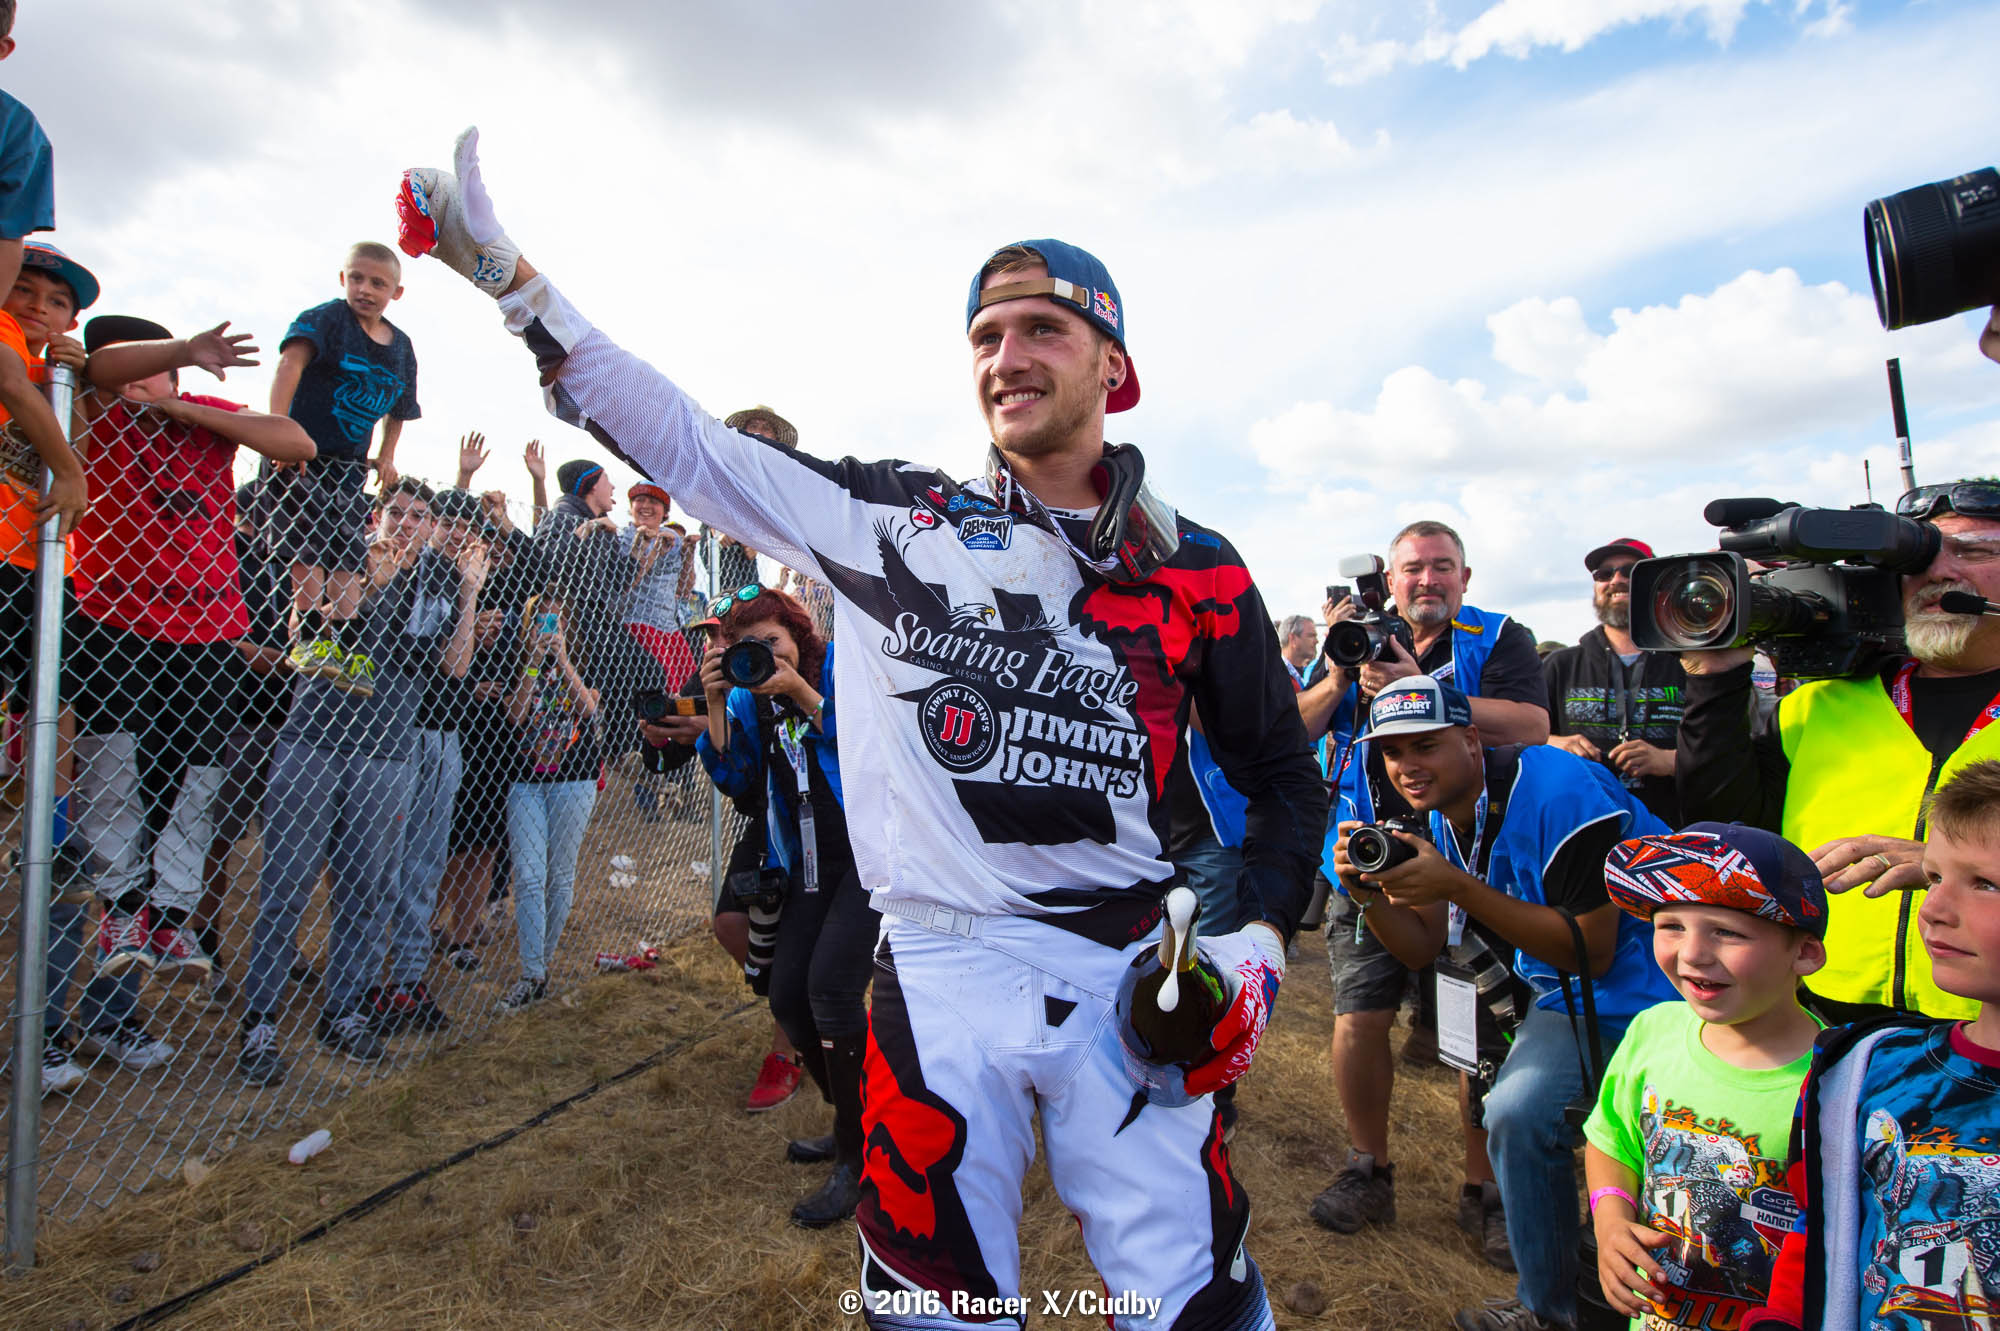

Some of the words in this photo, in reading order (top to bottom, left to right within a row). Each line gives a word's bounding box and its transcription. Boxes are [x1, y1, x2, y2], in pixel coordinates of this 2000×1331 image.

[881, 611, 1029, 689] Soaring
[1024, 648, 1140, 710] Eagle
[909, 655, 942, 671] CASINO
[955, 668, 987, 683] RESORT
[927, 688, 960, 719] JIMMY
[962, 691, 990, 733] JOHN'S
[1009, 705, 1149, 761] JIMMY
[1002, 745, 1138, 796] JOHN'S
[1914, 1246, 1946, 1288] 1
